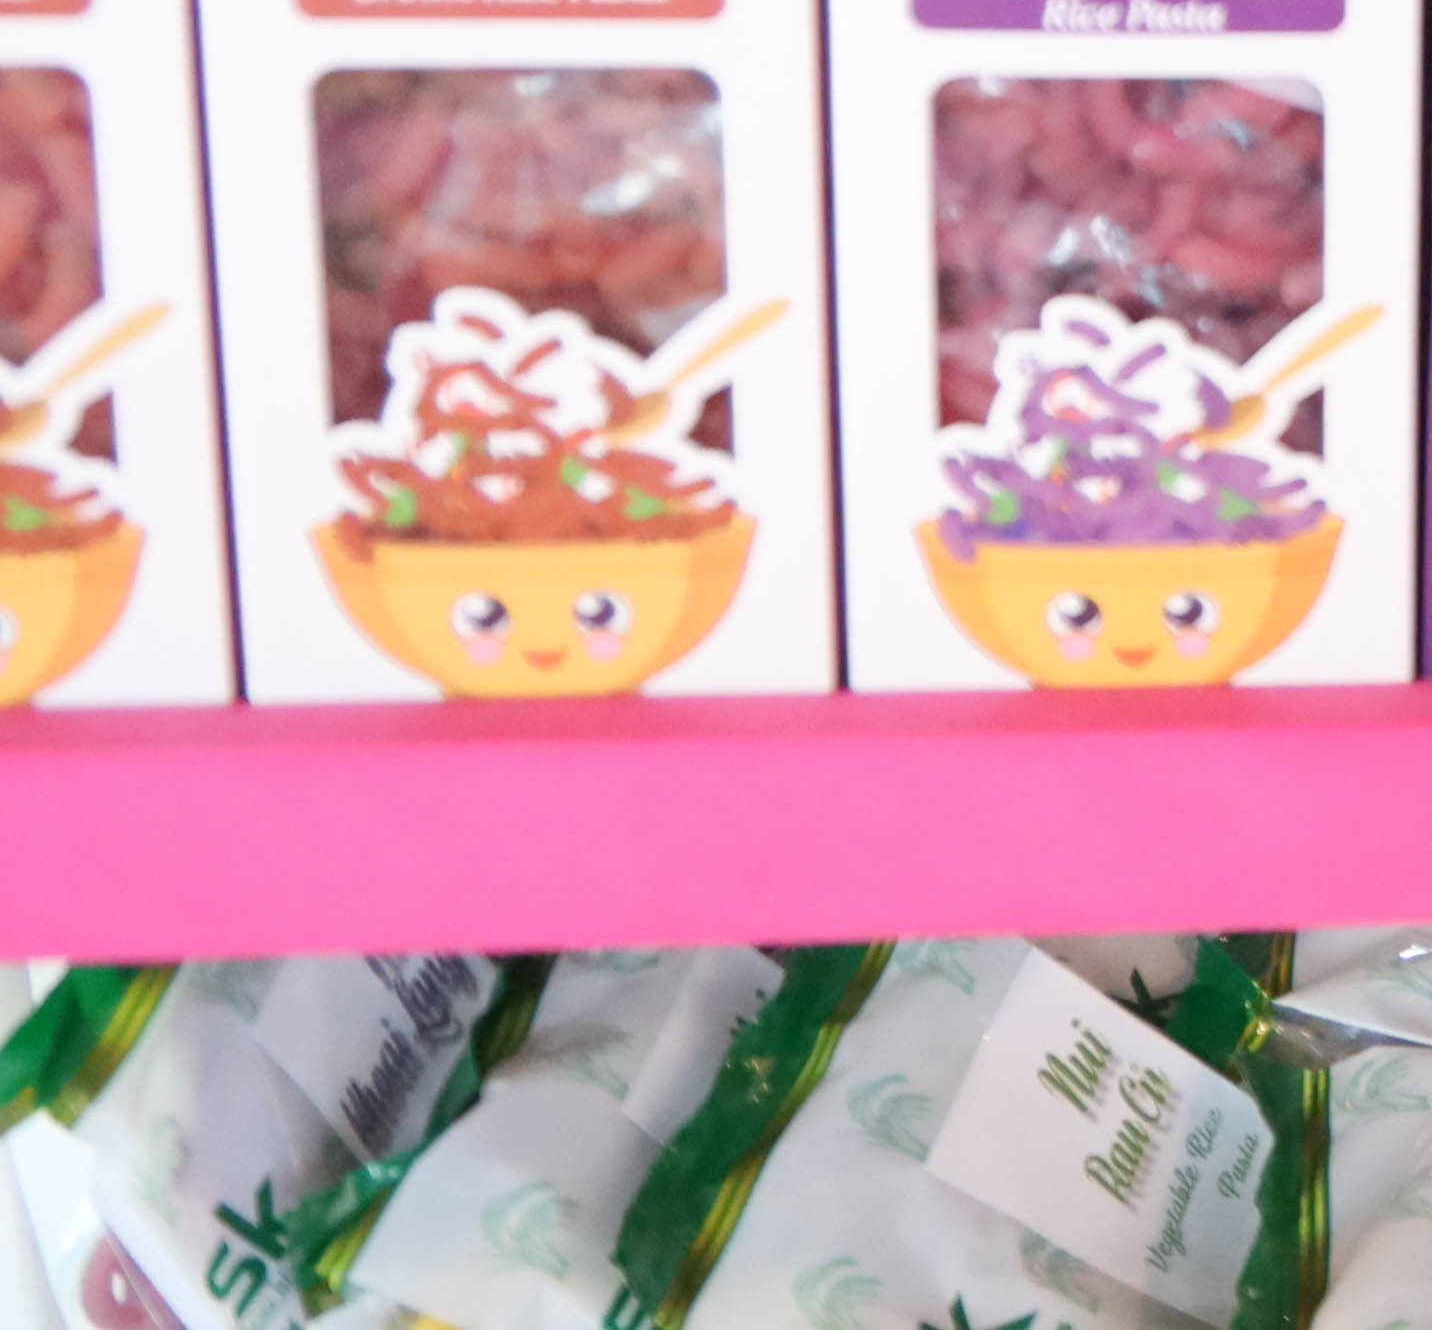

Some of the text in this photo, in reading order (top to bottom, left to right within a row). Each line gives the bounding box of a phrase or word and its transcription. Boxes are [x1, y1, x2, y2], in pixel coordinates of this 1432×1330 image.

[1037, 1018, 1116, 1114] Nui
[1084, 1119, 1152, 1205] Rau
[1145, 1107, 1222, 1274] Vegetable Rice
[1217, 1134, 1259, 1199] Pasta
